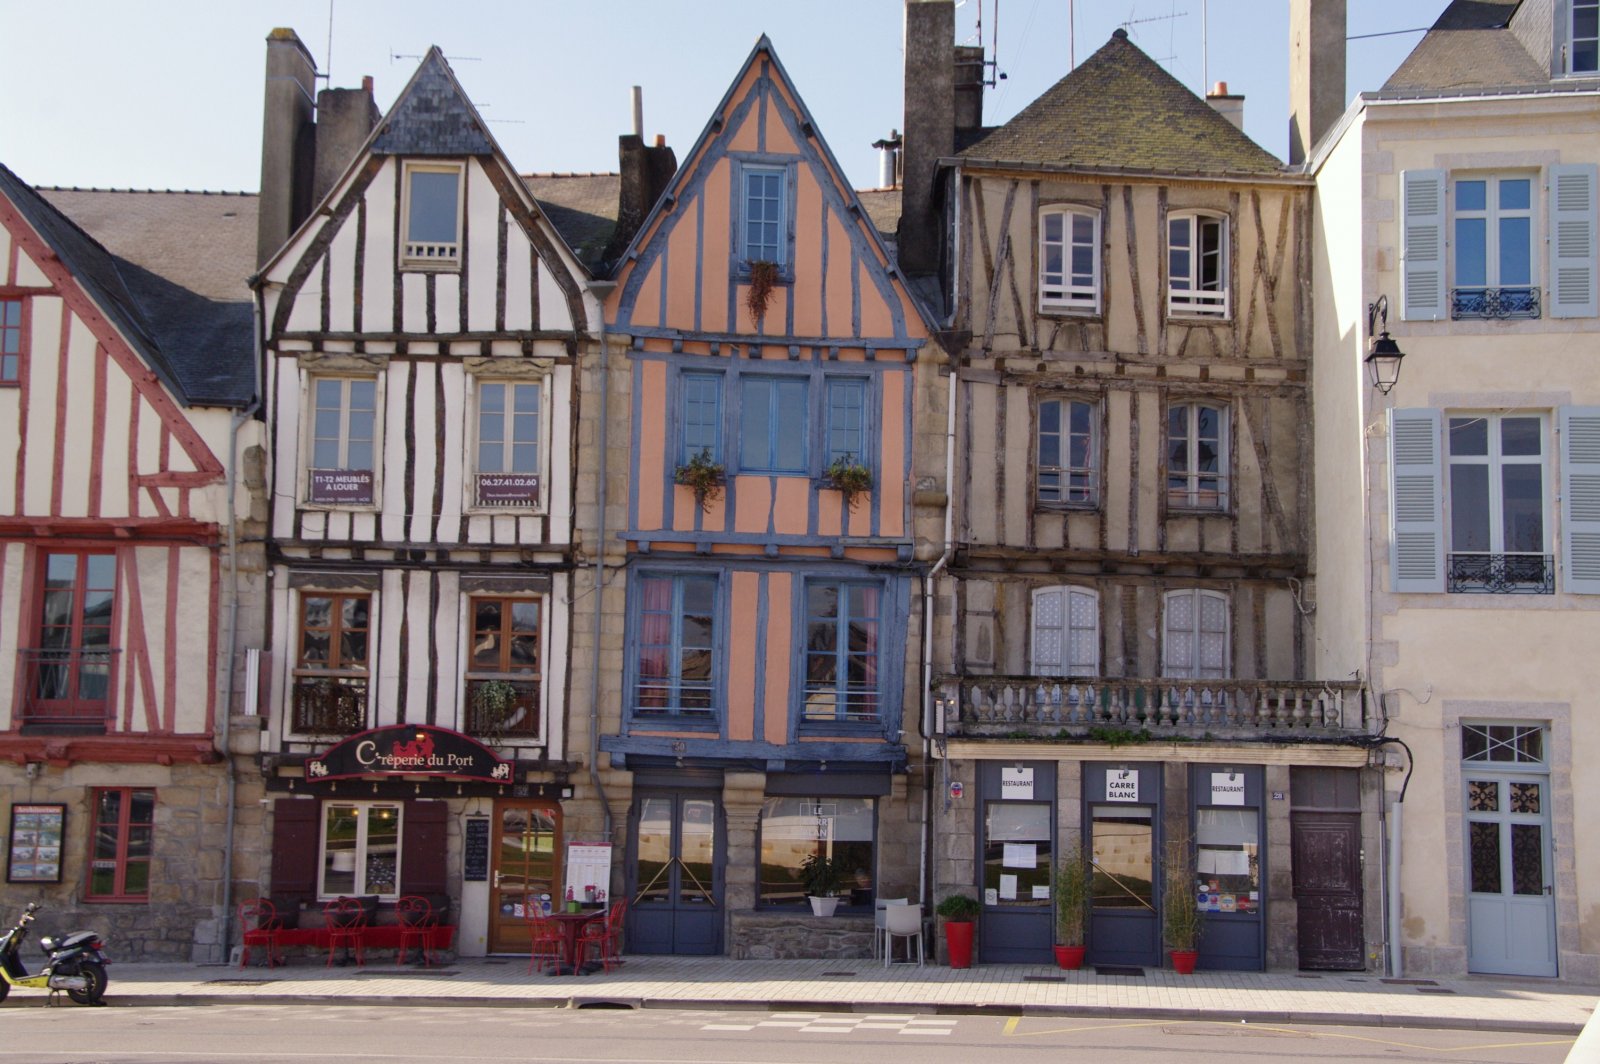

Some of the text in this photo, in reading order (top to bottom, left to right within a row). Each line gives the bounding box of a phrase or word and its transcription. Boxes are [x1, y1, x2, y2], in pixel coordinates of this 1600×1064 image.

[335, 473, 370, 483] MEUBLÉS
[481, 478, 537, 486] 06.27.41.02.60
[325, 483, 359, 491] A LOUER
[356, 740, 474, 769] Crêperie du Port
[1108, 791, 1136, 799] BLANC
[813, 807, 823, 815] LE
